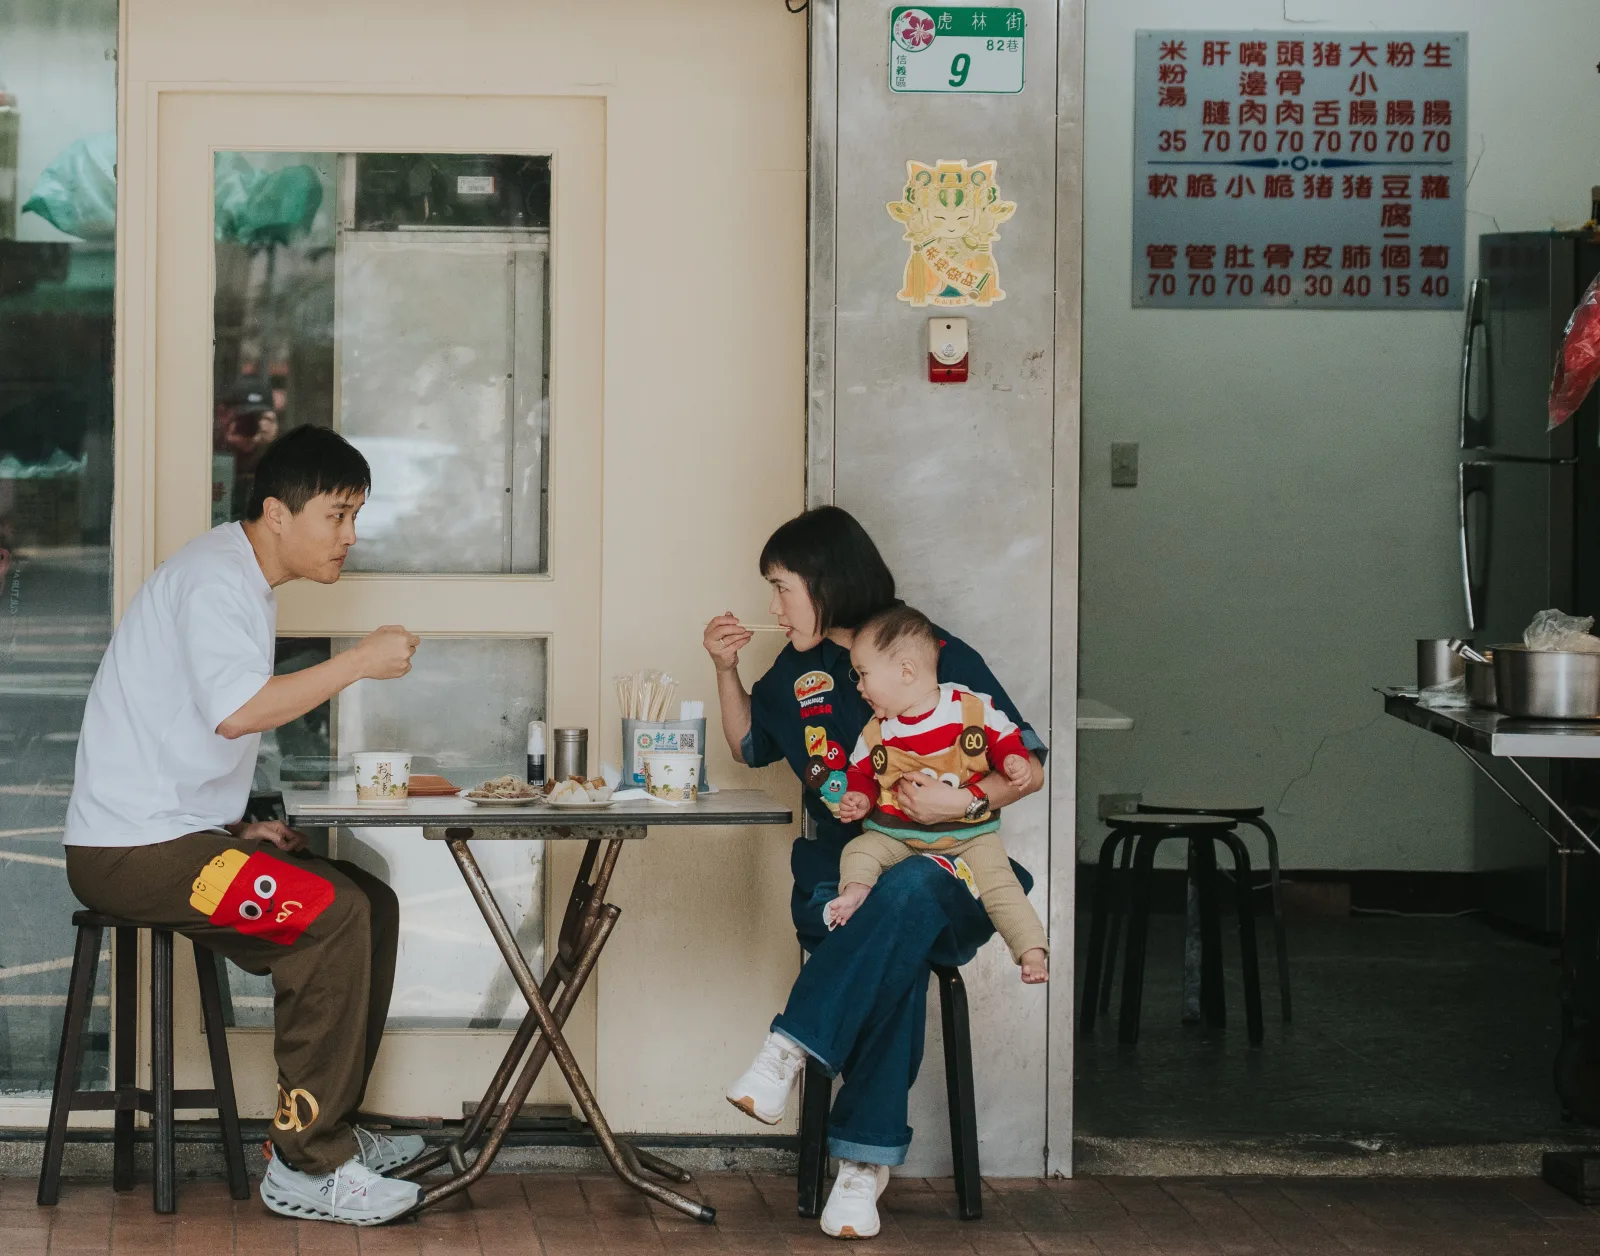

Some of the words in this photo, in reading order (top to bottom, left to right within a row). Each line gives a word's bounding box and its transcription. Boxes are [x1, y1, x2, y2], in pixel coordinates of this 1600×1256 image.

[937, 12, 1022, 31] 虎林街
[986, 39, 1019, 52] 82巷
[896, 55, 907, 87] 信義區
[948, 53, 971, 87] 9
[1159, 41, 1187, 107] 米粉湯
[1239, 42, 1267, 126] 嘴邊肉
[1275, 41, 1304, 126] 頭骨肉
[1349, 42, 1378, 126] 大小腸
[1160, 130, 1186, 152] 35
[1203, 130, 1230, 152] 70
[1240, 130, 1267, 152] 70
[1277, 130, 1304, 152] 70
[1314, 130, 1341, 152] 70
[1350, 130, 1377, 152] 70
[1387, 130, 1414, 152] 70
[1424, 130, 1450, 152] 70
[1381, 175, 1411, 269] 豆腐一個
[1148, 274, 1176, 296] 70
[1188, 274, 1215, 296] 70
[1226, 274, 1253, 296] 70
[1264, 275, 1291, 297] 40
[1304, 274, 1333, 297] 30
[1342, 275, 1371, 297] 40
[1384, 275, 1410, 297] 15
[1421, 275, 1449, 297] 40
[965, 733, 984, 750] GO
[872, 750, 886, 770] GO
